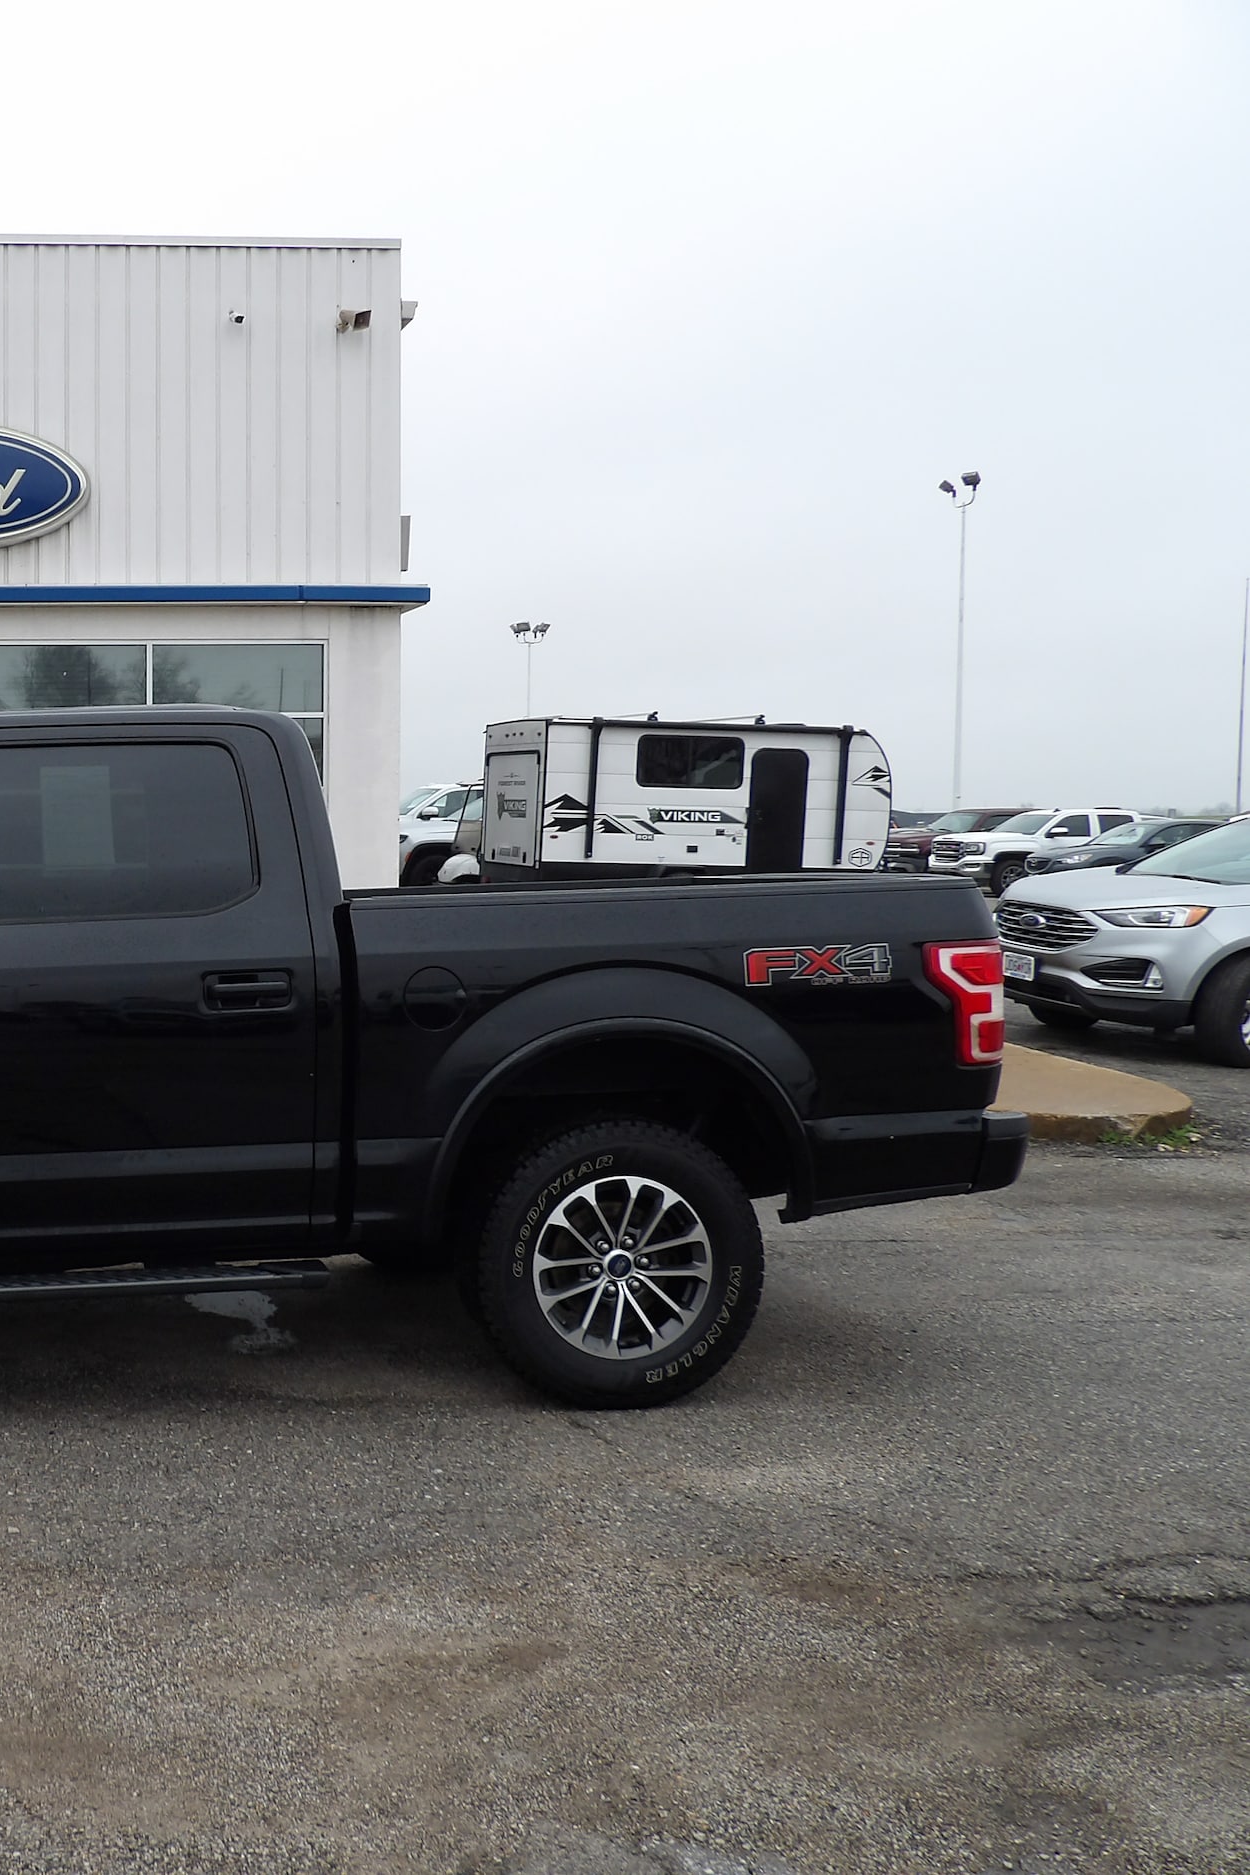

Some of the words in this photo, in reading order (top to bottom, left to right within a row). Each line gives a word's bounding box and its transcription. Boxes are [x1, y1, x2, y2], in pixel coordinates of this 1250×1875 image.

[660, 810, 722, 822] VIKING
[743, 943, 893, 987] FX4
[512, 1154, 615, 1279] GOODYEAR
[645, 1264, 743, 1384] WRANGLER
